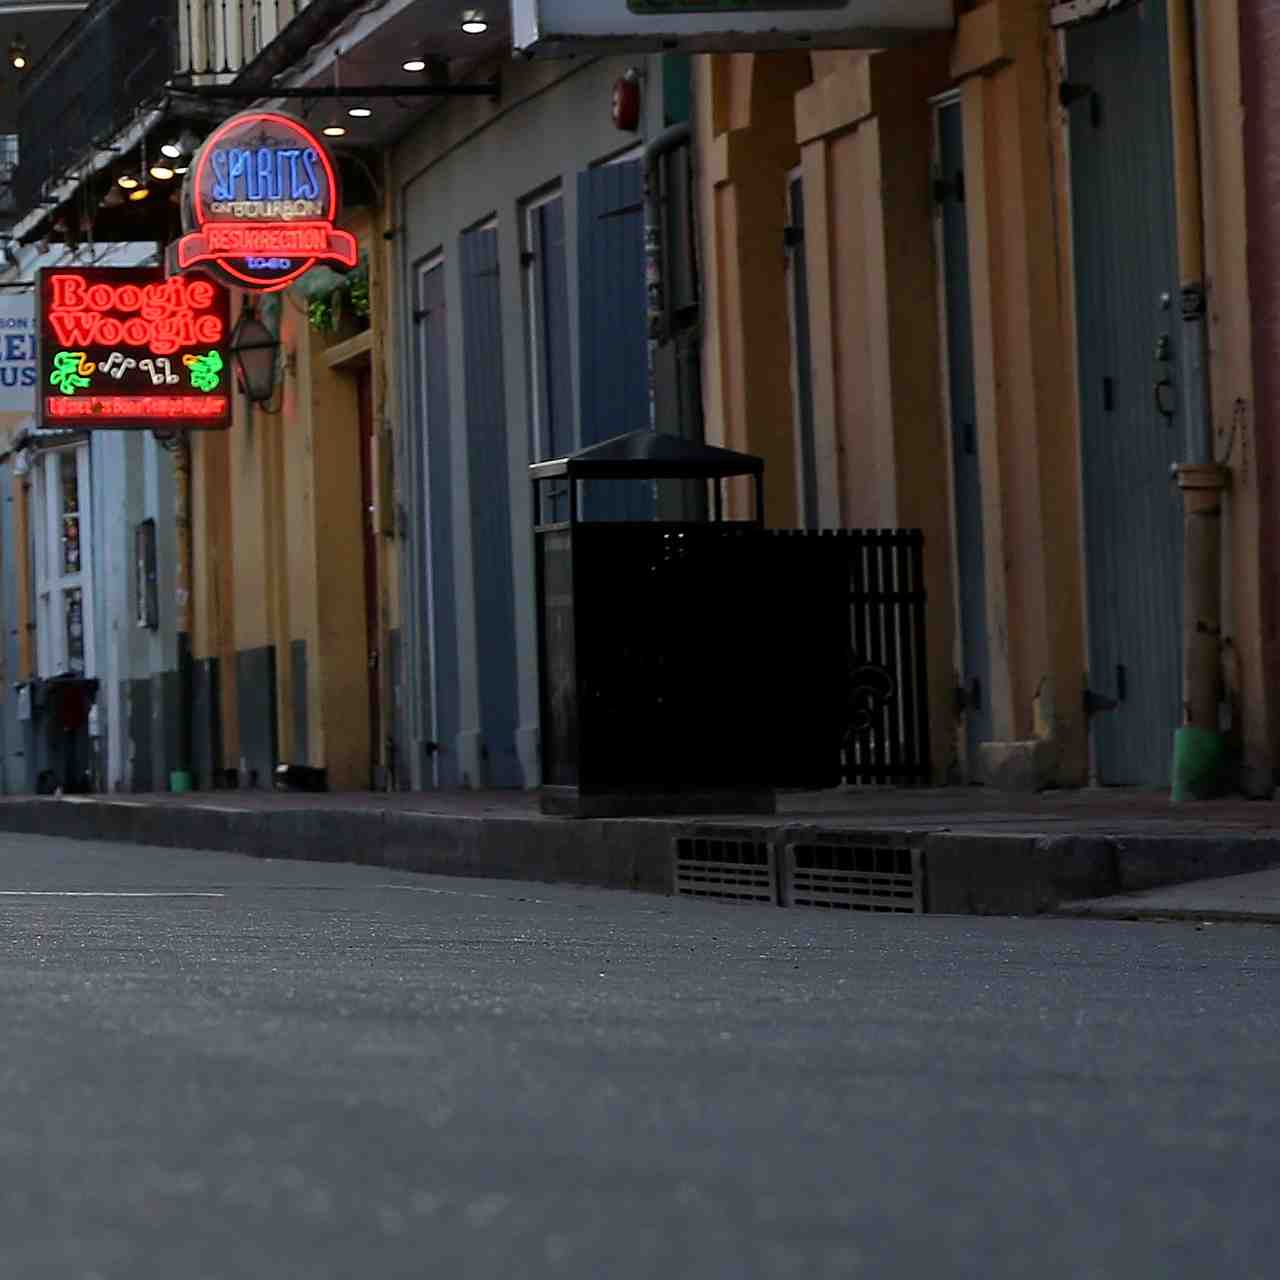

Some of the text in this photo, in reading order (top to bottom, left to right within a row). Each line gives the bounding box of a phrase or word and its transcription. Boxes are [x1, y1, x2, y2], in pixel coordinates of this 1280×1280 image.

[211, 145, 320, 201] SPIRITS
[209, 228, 328, 250] RESURRECTION
[50, 274, 214, 320] Boogie
[49, 310, 222, 355] Woogie
